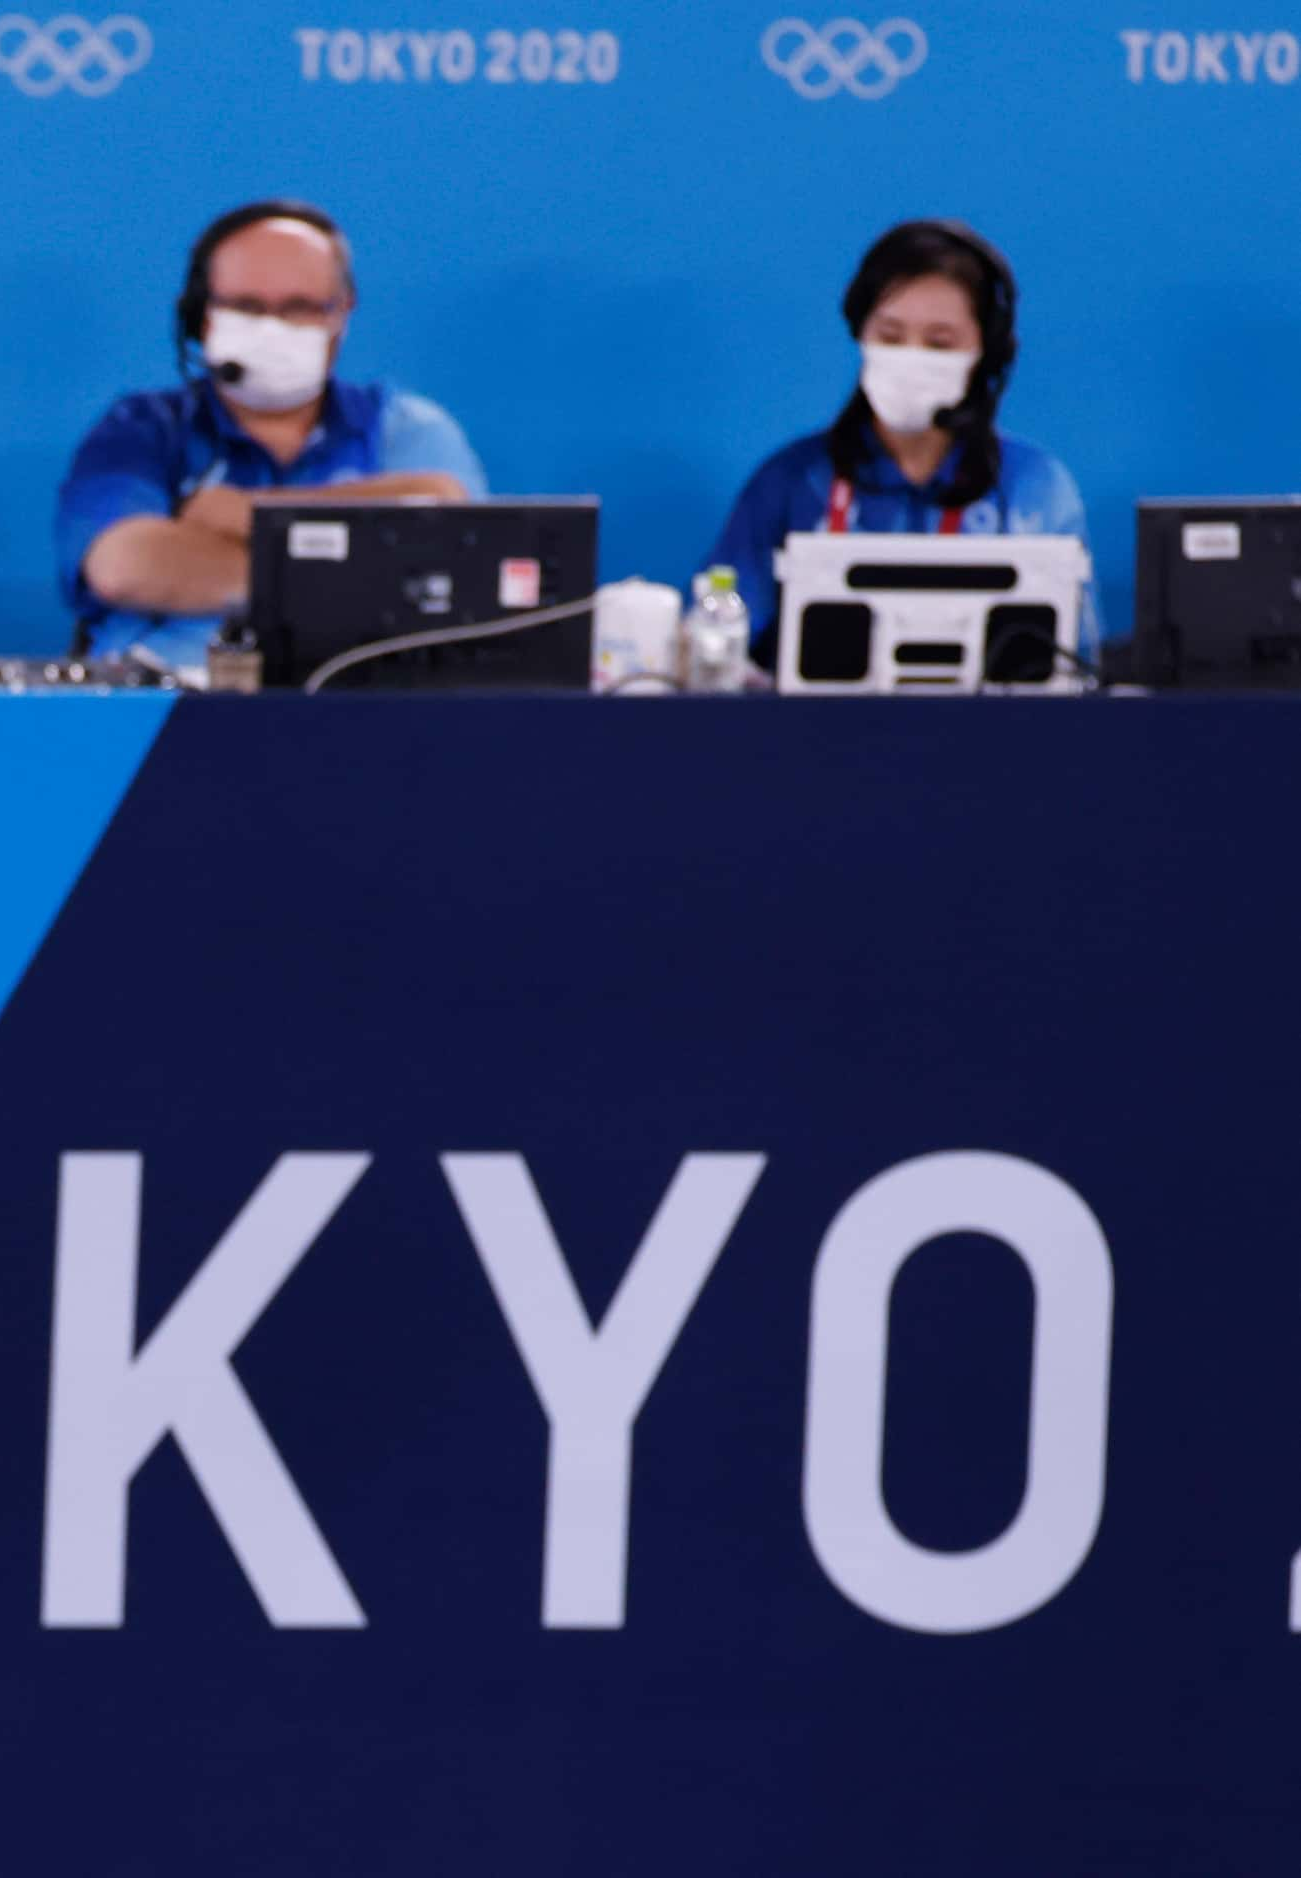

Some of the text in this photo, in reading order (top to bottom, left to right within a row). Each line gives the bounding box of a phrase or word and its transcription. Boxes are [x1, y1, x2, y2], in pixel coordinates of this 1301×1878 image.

[296, 27, 619, 83] TOKYO 2020
[1120, 29, 1301, 84] TOKYO
